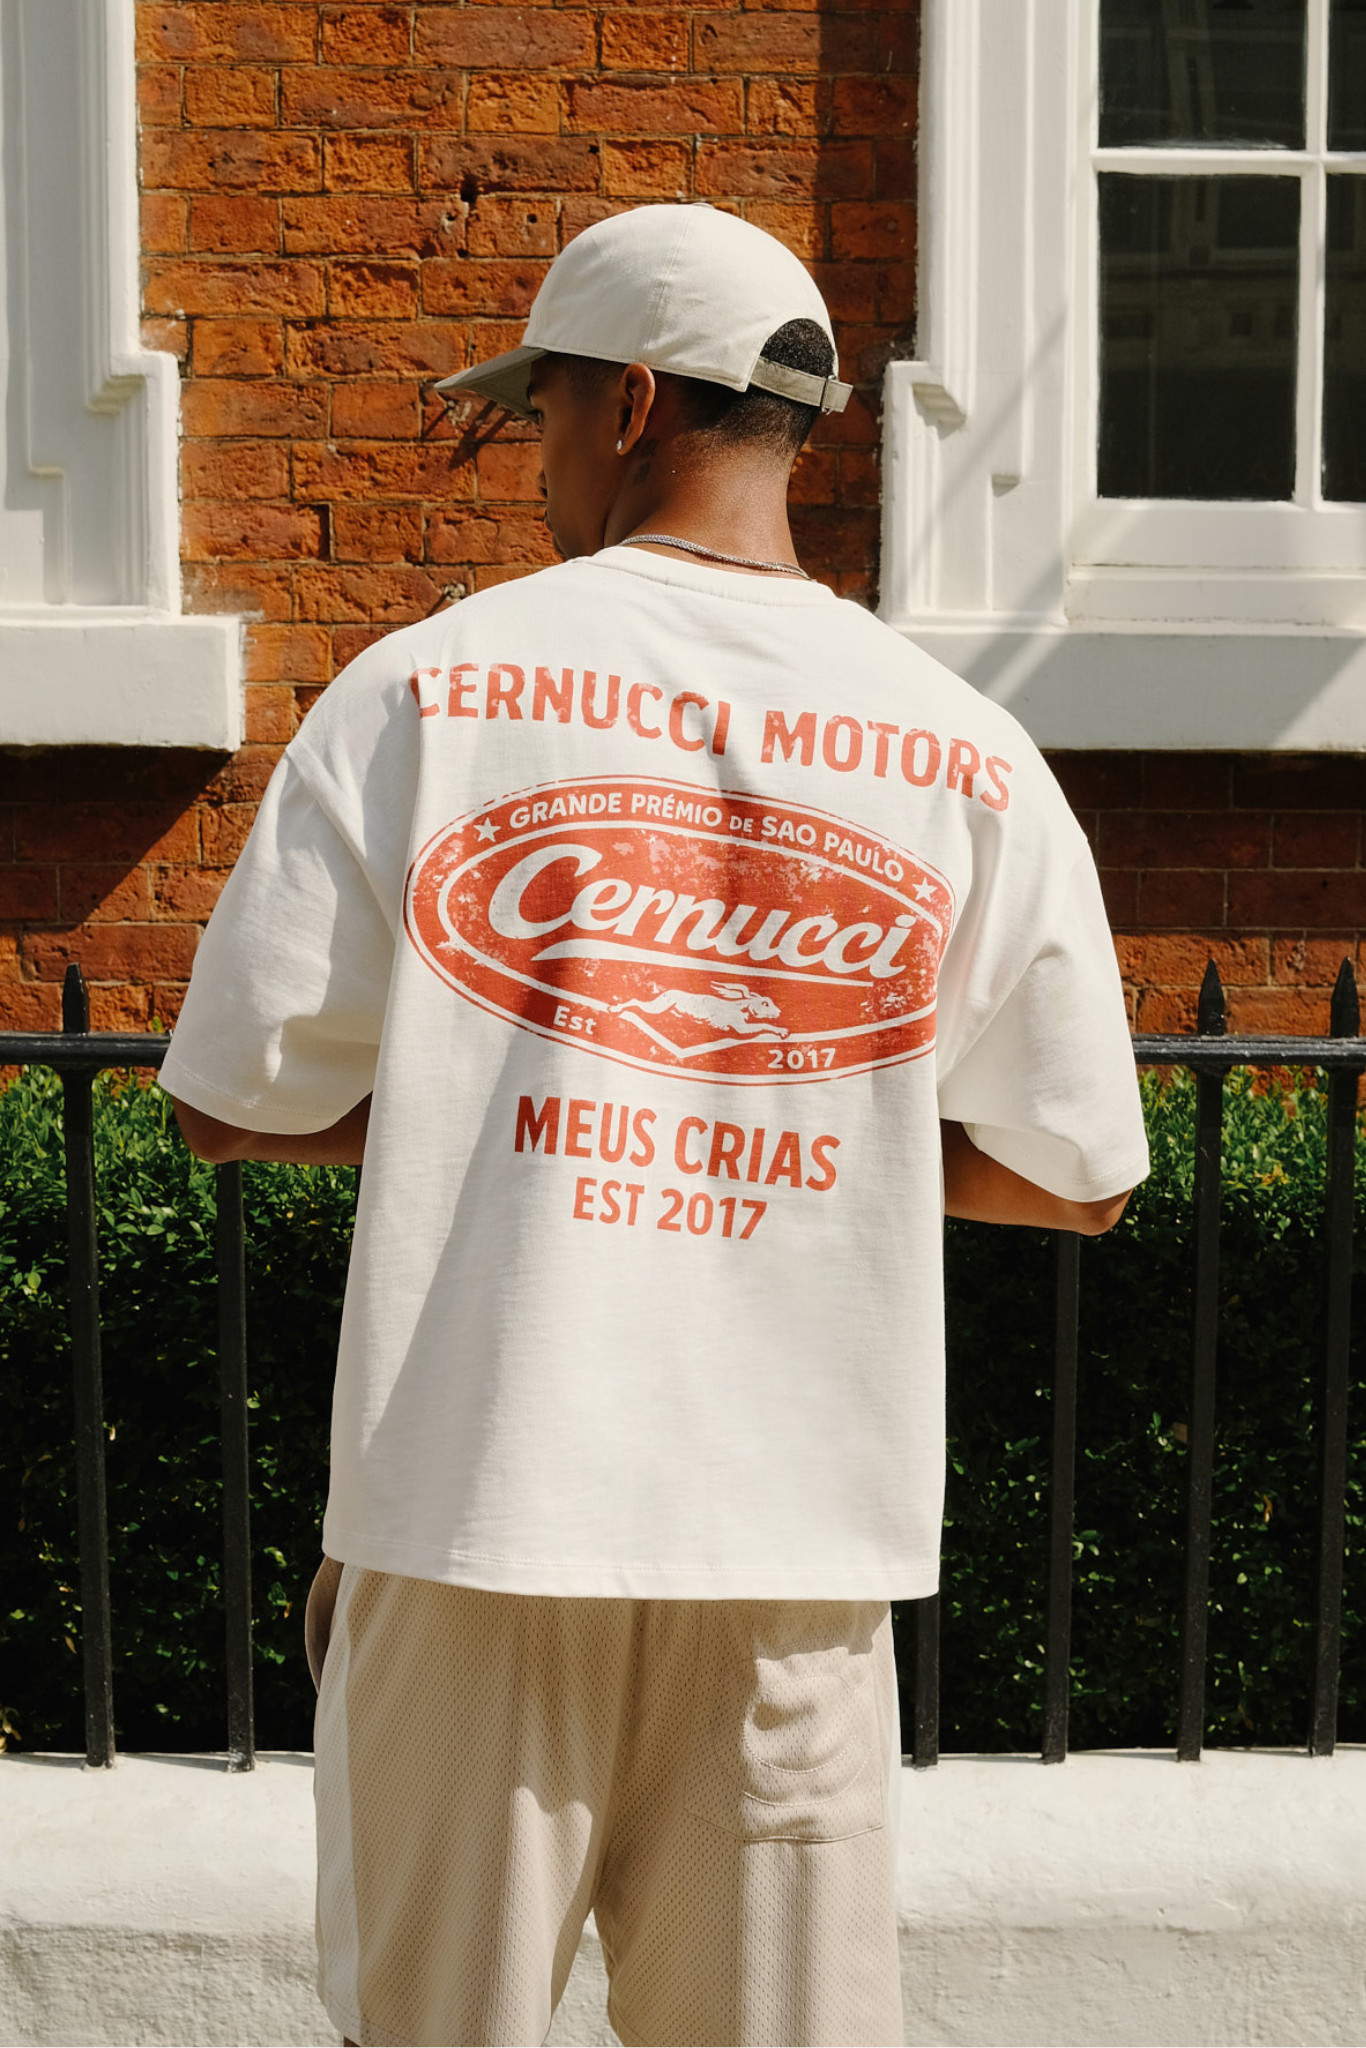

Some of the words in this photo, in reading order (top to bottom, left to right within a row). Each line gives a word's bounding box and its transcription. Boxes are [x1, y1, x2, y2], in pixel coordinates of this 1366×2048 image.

[409, 663, 731, 755] CERNUCCI
[760, 710, 1013, 811] MOTORS
[509, 792, 622, 829] GRANDE
[631, 793, 722, 827] PRÉMIO
[729, 816, 753, 833] DE
[761, 816, 817, 847] SAO
[823, 831, 904, 882] PAULO
[488, 843, 917, 978] Cernucci
[553, 1006, 597, 1035] Est
[768, 1047, 836, 1070] 2017
[514, 1095, 657, 1167] MEUS
[674, 1116, 841, 1191] CRIAS
[573, 1176, 645, 1226] EST
[657, 1188, 767, 1239] 2017
